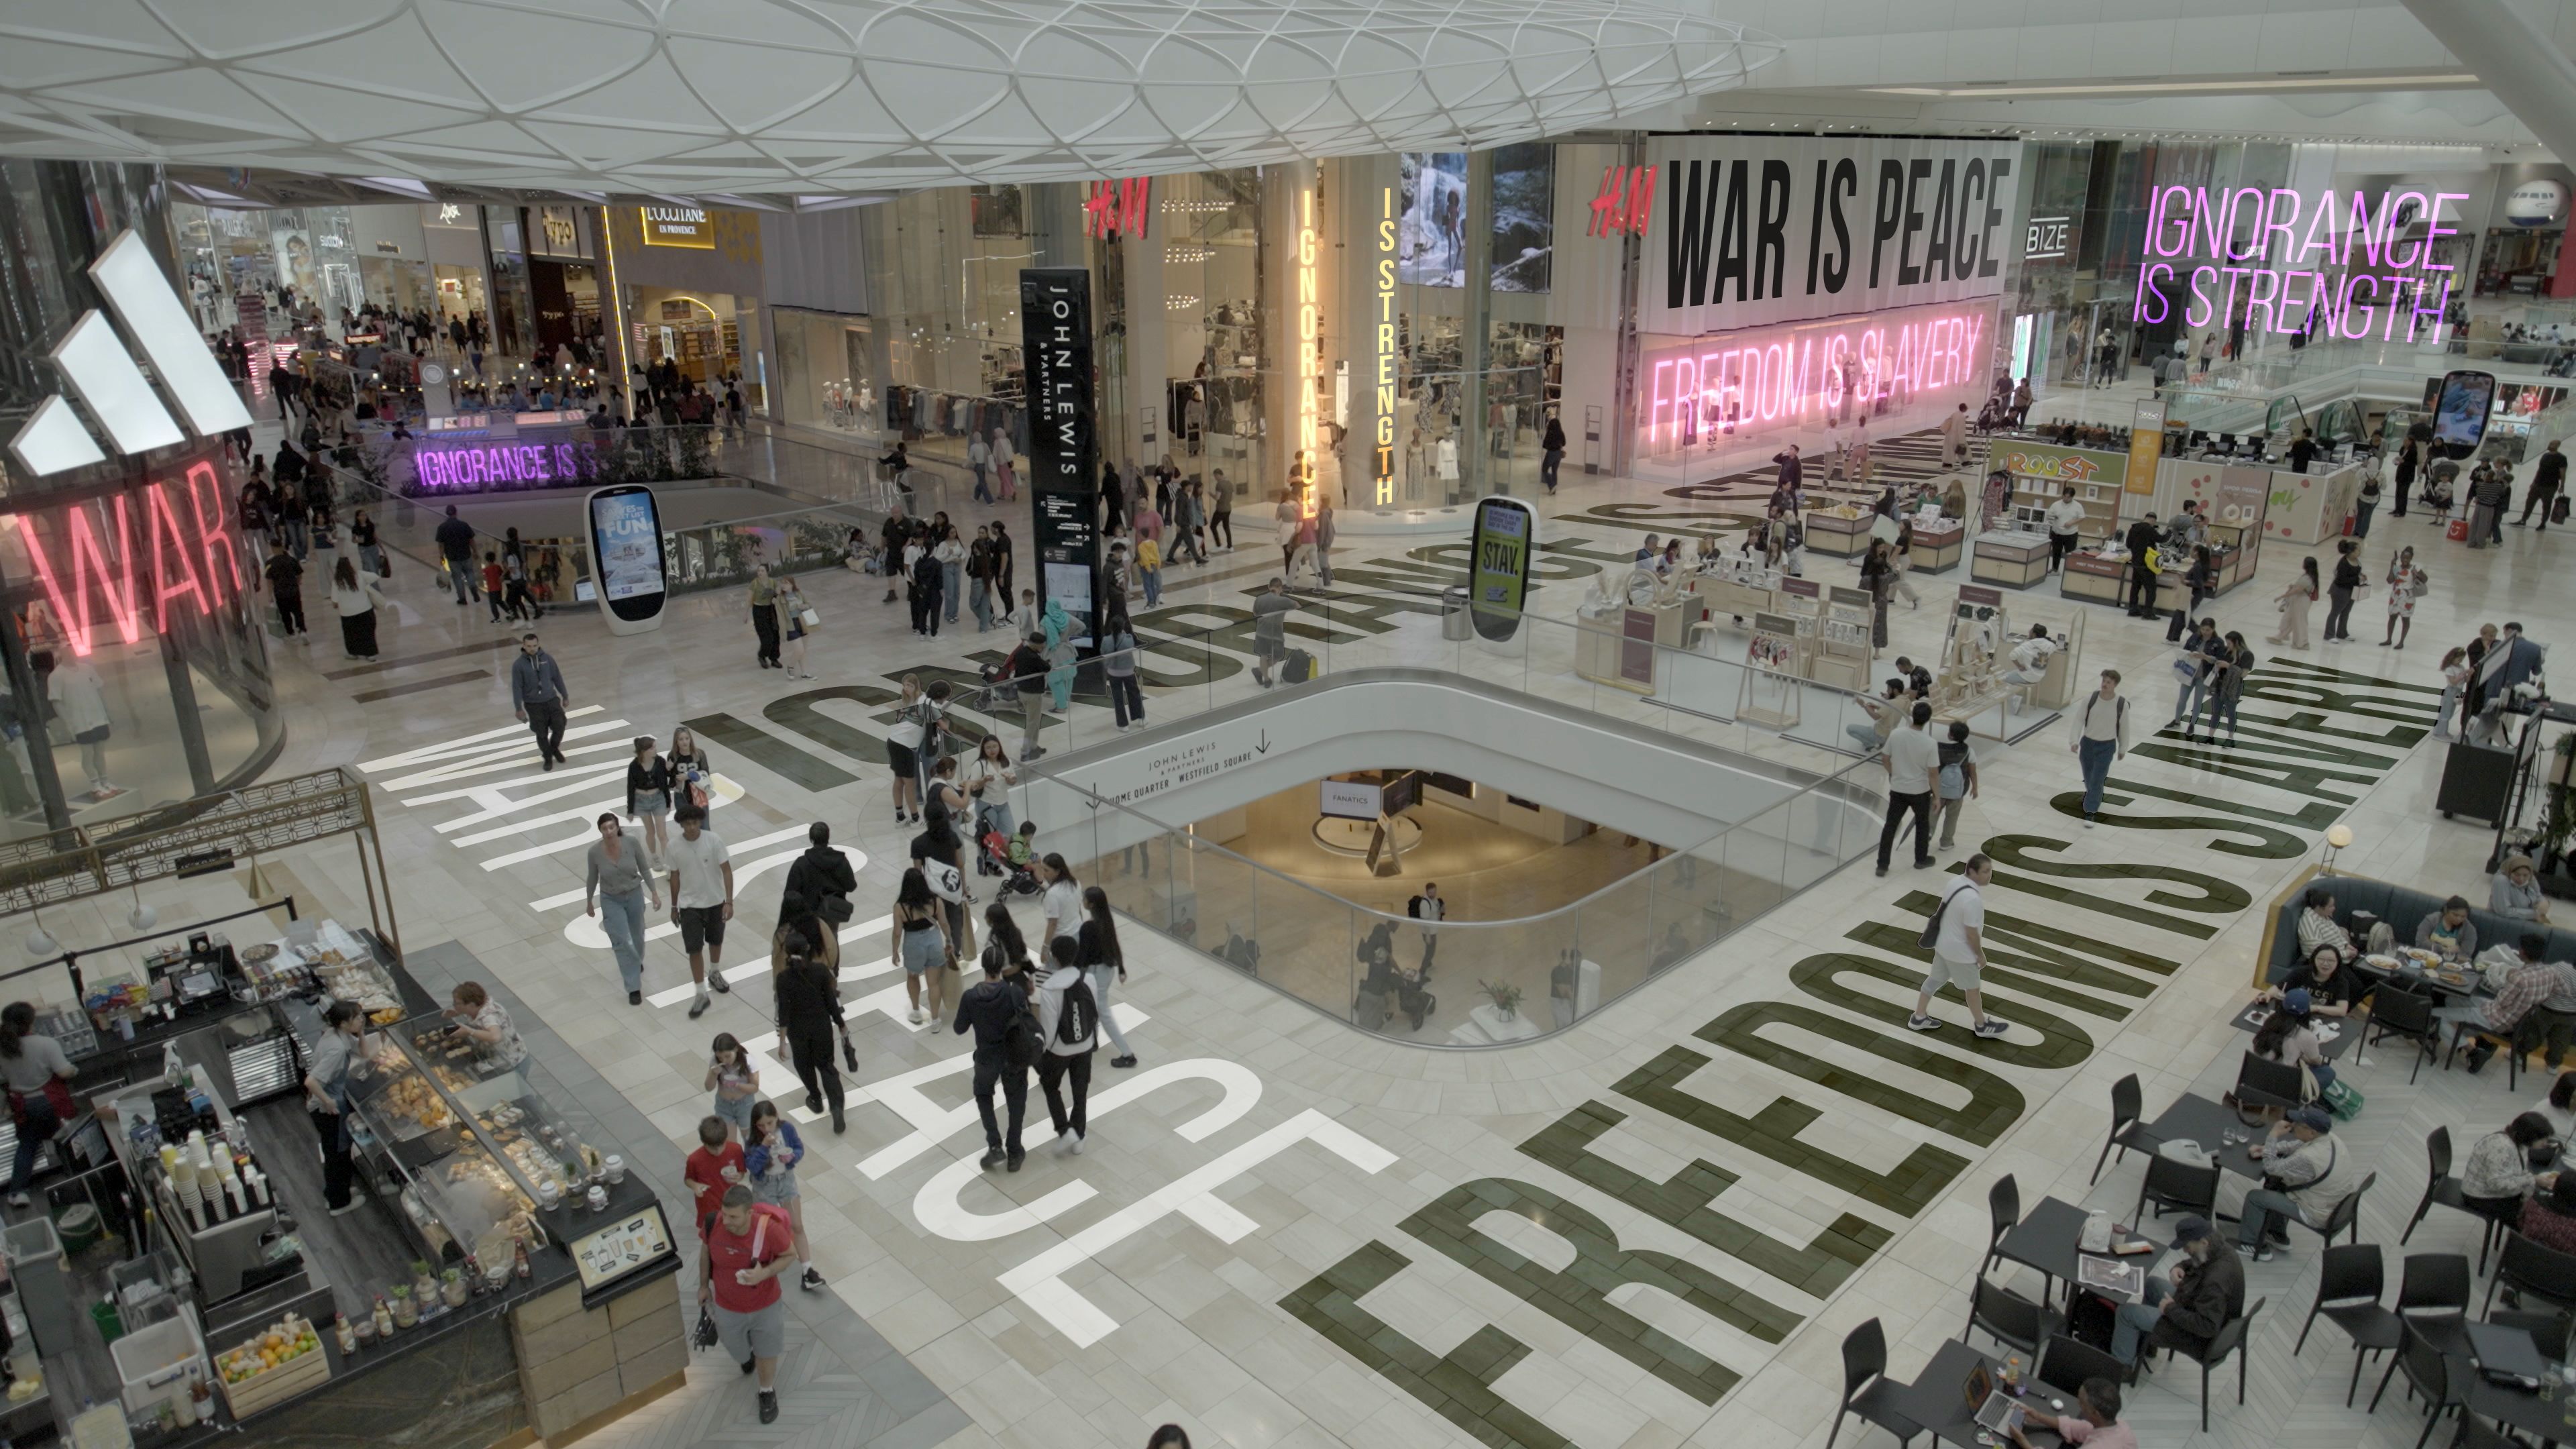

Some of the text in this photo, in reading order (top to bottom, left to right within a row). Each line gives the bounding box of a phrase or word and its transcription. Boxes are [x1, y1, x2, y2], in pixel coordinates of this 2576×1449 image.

[543, 213, 572, 246] Typo
[659, 225, 697, 235] EN PROVENCE
[1081, 176, 1152, 241] H&M
[1587, 165, 1658, 239] H&M
[1668, 157, 2011, 309] WAR IS PEACE
[2143, 185, 2469, 272] IGNORANCE
[2026, 223, 2068, 254] BIZE
[1050, 286, 1073, 367] JOHN
[2133, 262, 2451, 345] IS STRENGTH
[1298, 191, 1319, 519] IGNORANCE
[1377, 187, 1396, 506] IS STRENGTH
[1650, 313, 1984, 443] FREEDOM IS SLAVERY
[1039, 341, 1051, 421] & PARTNERS
[1057, 383, 1076, 475] LEWIS
[417, 445, 550, 486] IGNORANCE
[553, 443, 577, 478] IS
[2006, 452, 2100, 480] ROOST
[17, 459, 242, 657] WAR
[604, 517, 648, 537] FUN
[1483, 541, 1518, 576] STAY.
[1134, 779, 1169, 798] QUARTER
[1179, 763, 1220, 783] WESTFIELD
[1224, 751, 1252, 768] SQUARE
[1148, 741, 1217, 771] JOHN LEWIS
[1167, 757, 1205, 773] PARTNERS
[1332, 794, 1368, 804] FANATICS
[1945, 832, 2254, 938] IS
[2301, 985, 2333, 1000] UCCI
